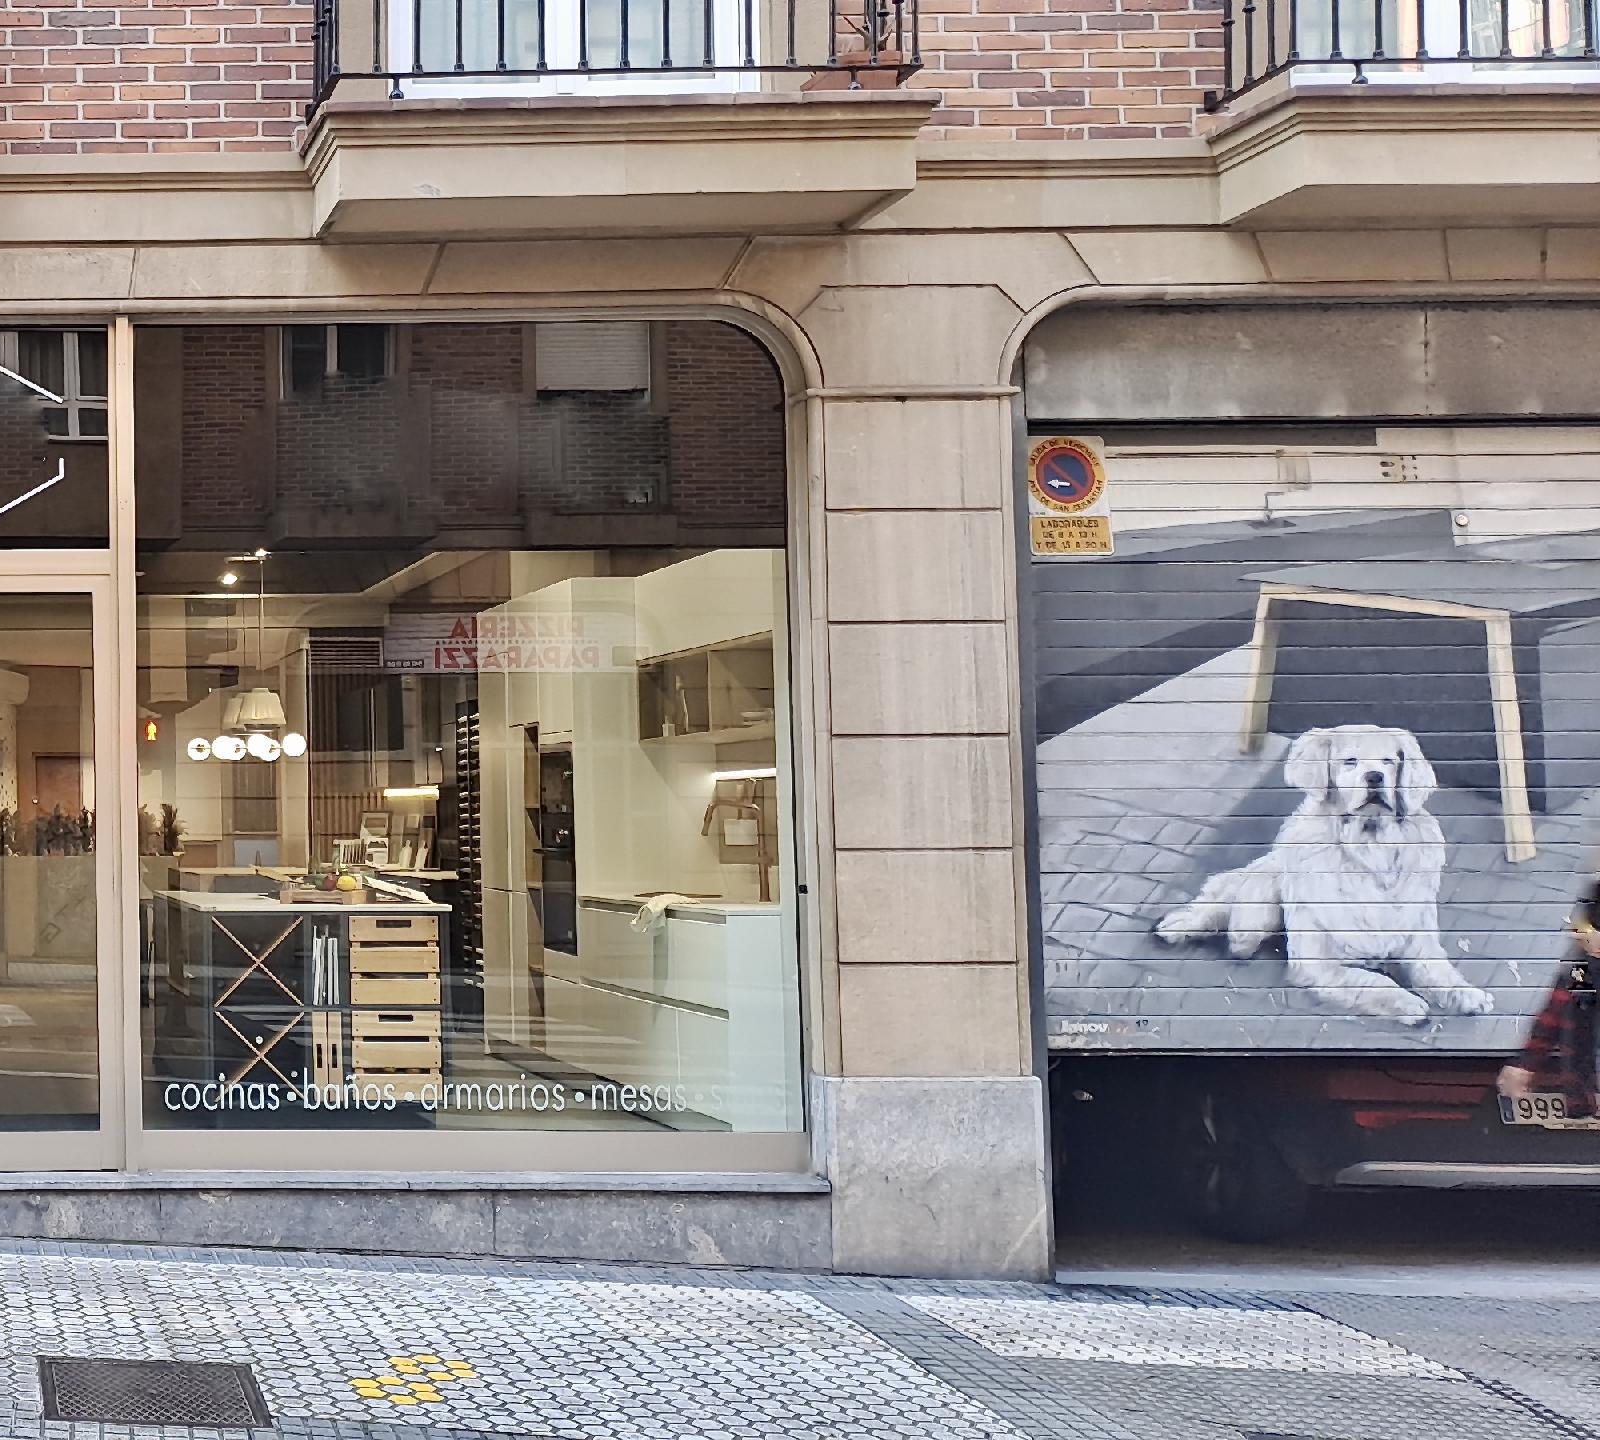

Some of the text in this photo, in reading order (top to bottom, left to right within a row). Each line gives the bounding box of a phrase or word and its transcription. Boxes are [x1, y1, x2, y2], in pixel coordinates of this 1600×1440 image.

[1040, 519, 1100, 528] LABORABLES
[163, 1072, 281, 1111] cocinas
[302, 1066, 397, 1111] baños
[419, 1073, 566, 1111] armarios
[590, 1082, 688, 1112] mesas
[1517, 1097, 1566, 1120] 999
